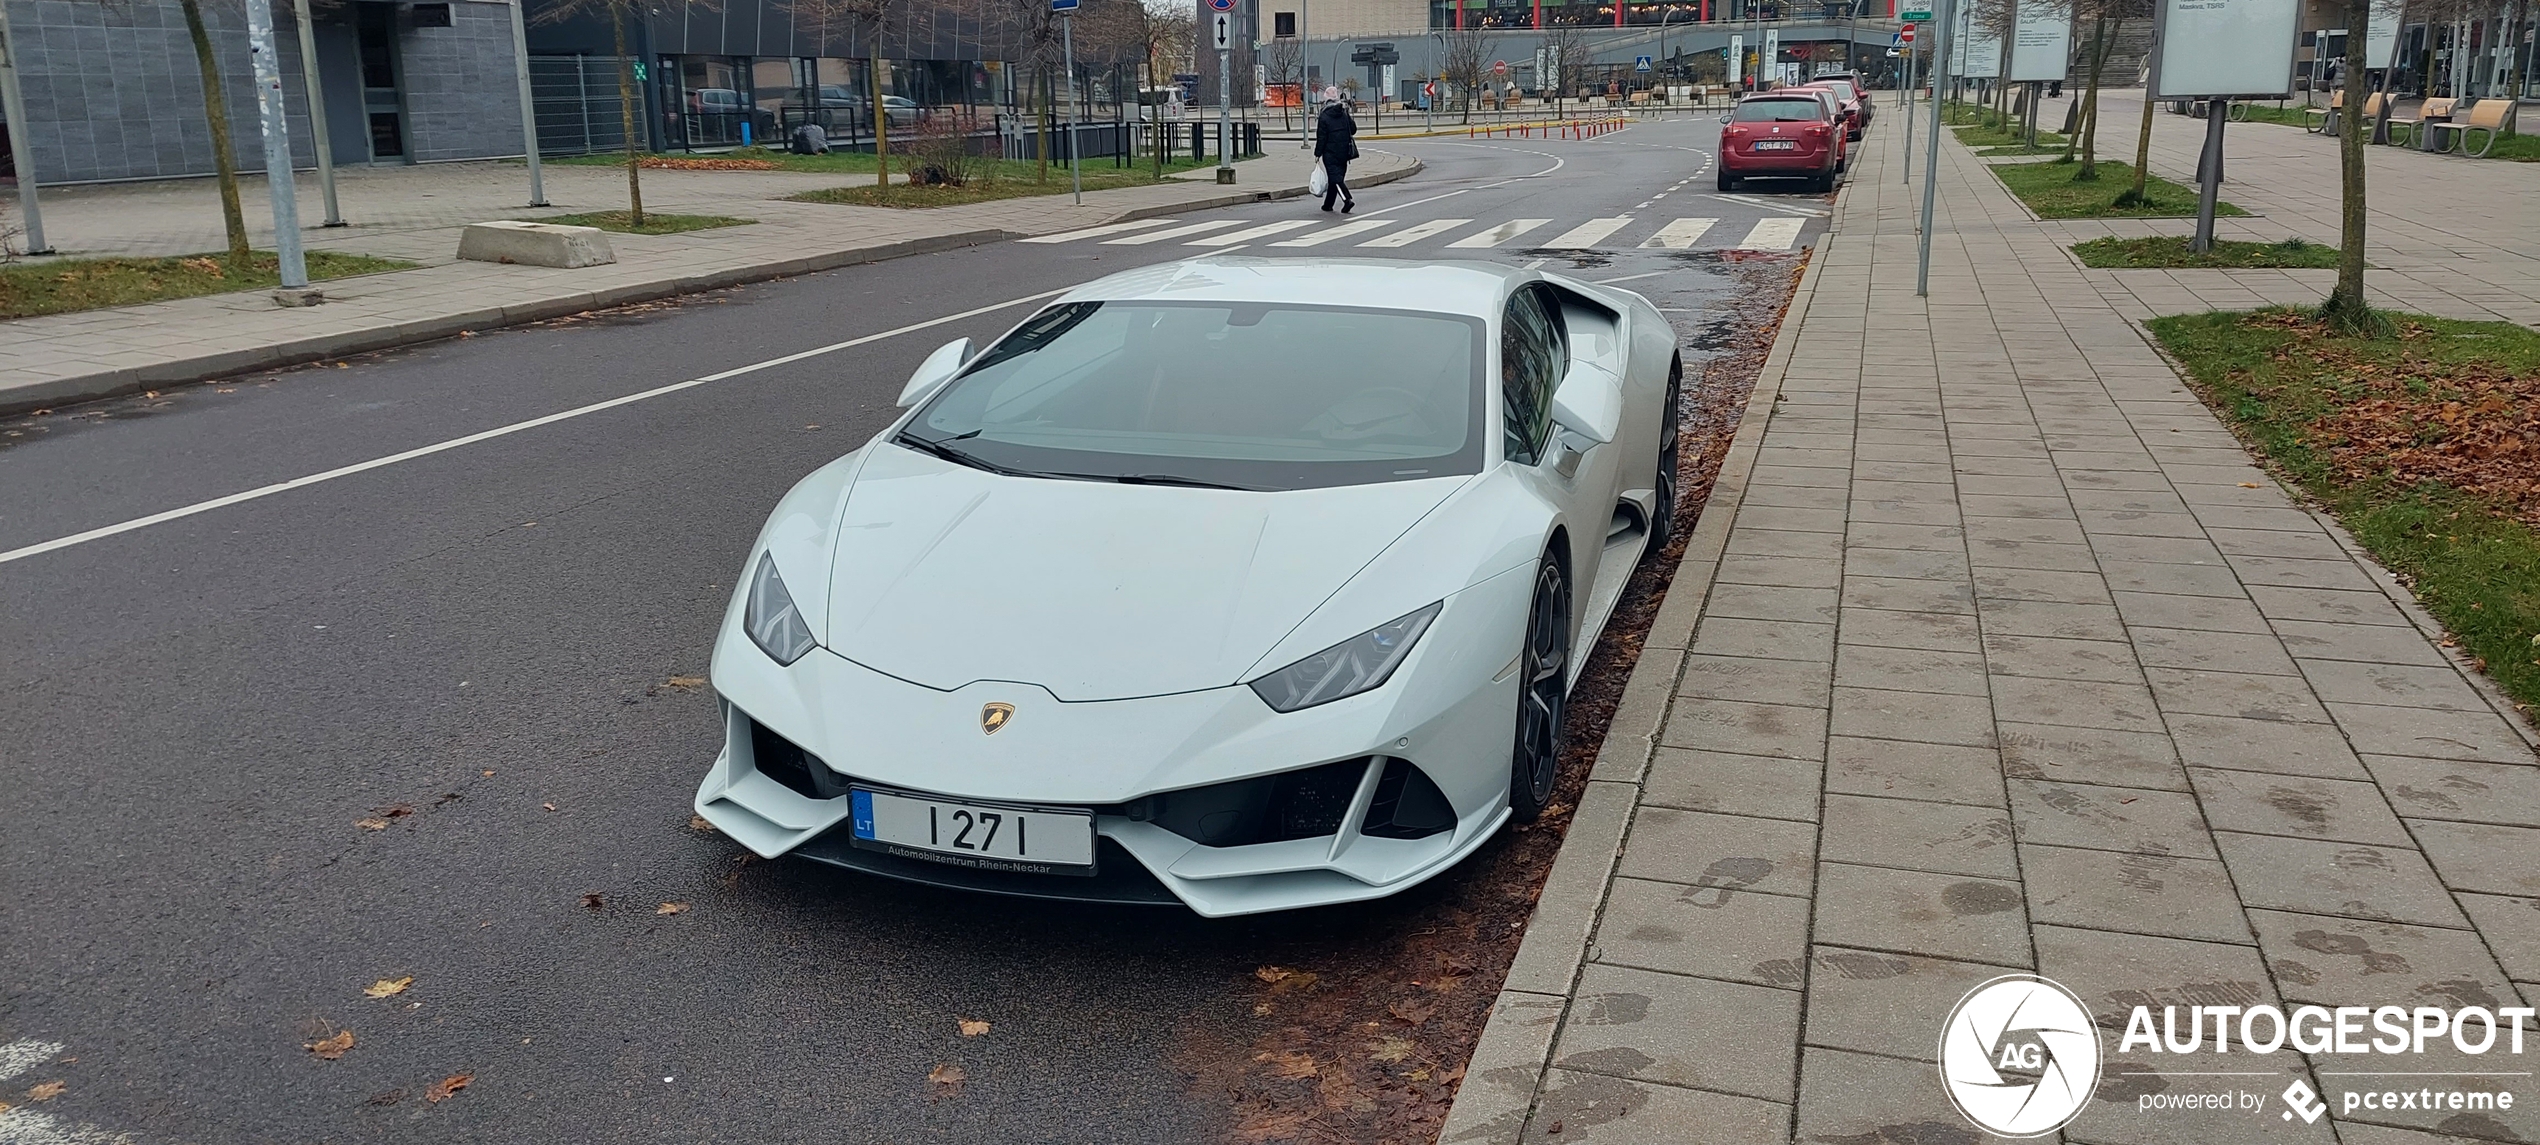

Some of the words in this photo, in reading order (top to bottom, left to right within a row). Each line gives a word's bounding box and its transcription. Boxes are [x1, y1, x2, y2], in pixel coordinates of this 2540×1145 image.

[856, 819, 872, 832] LT
[888, 845, 976, 868] Automobilzentrum
[979, 855, 1051, 874] Rhein-Neckar
